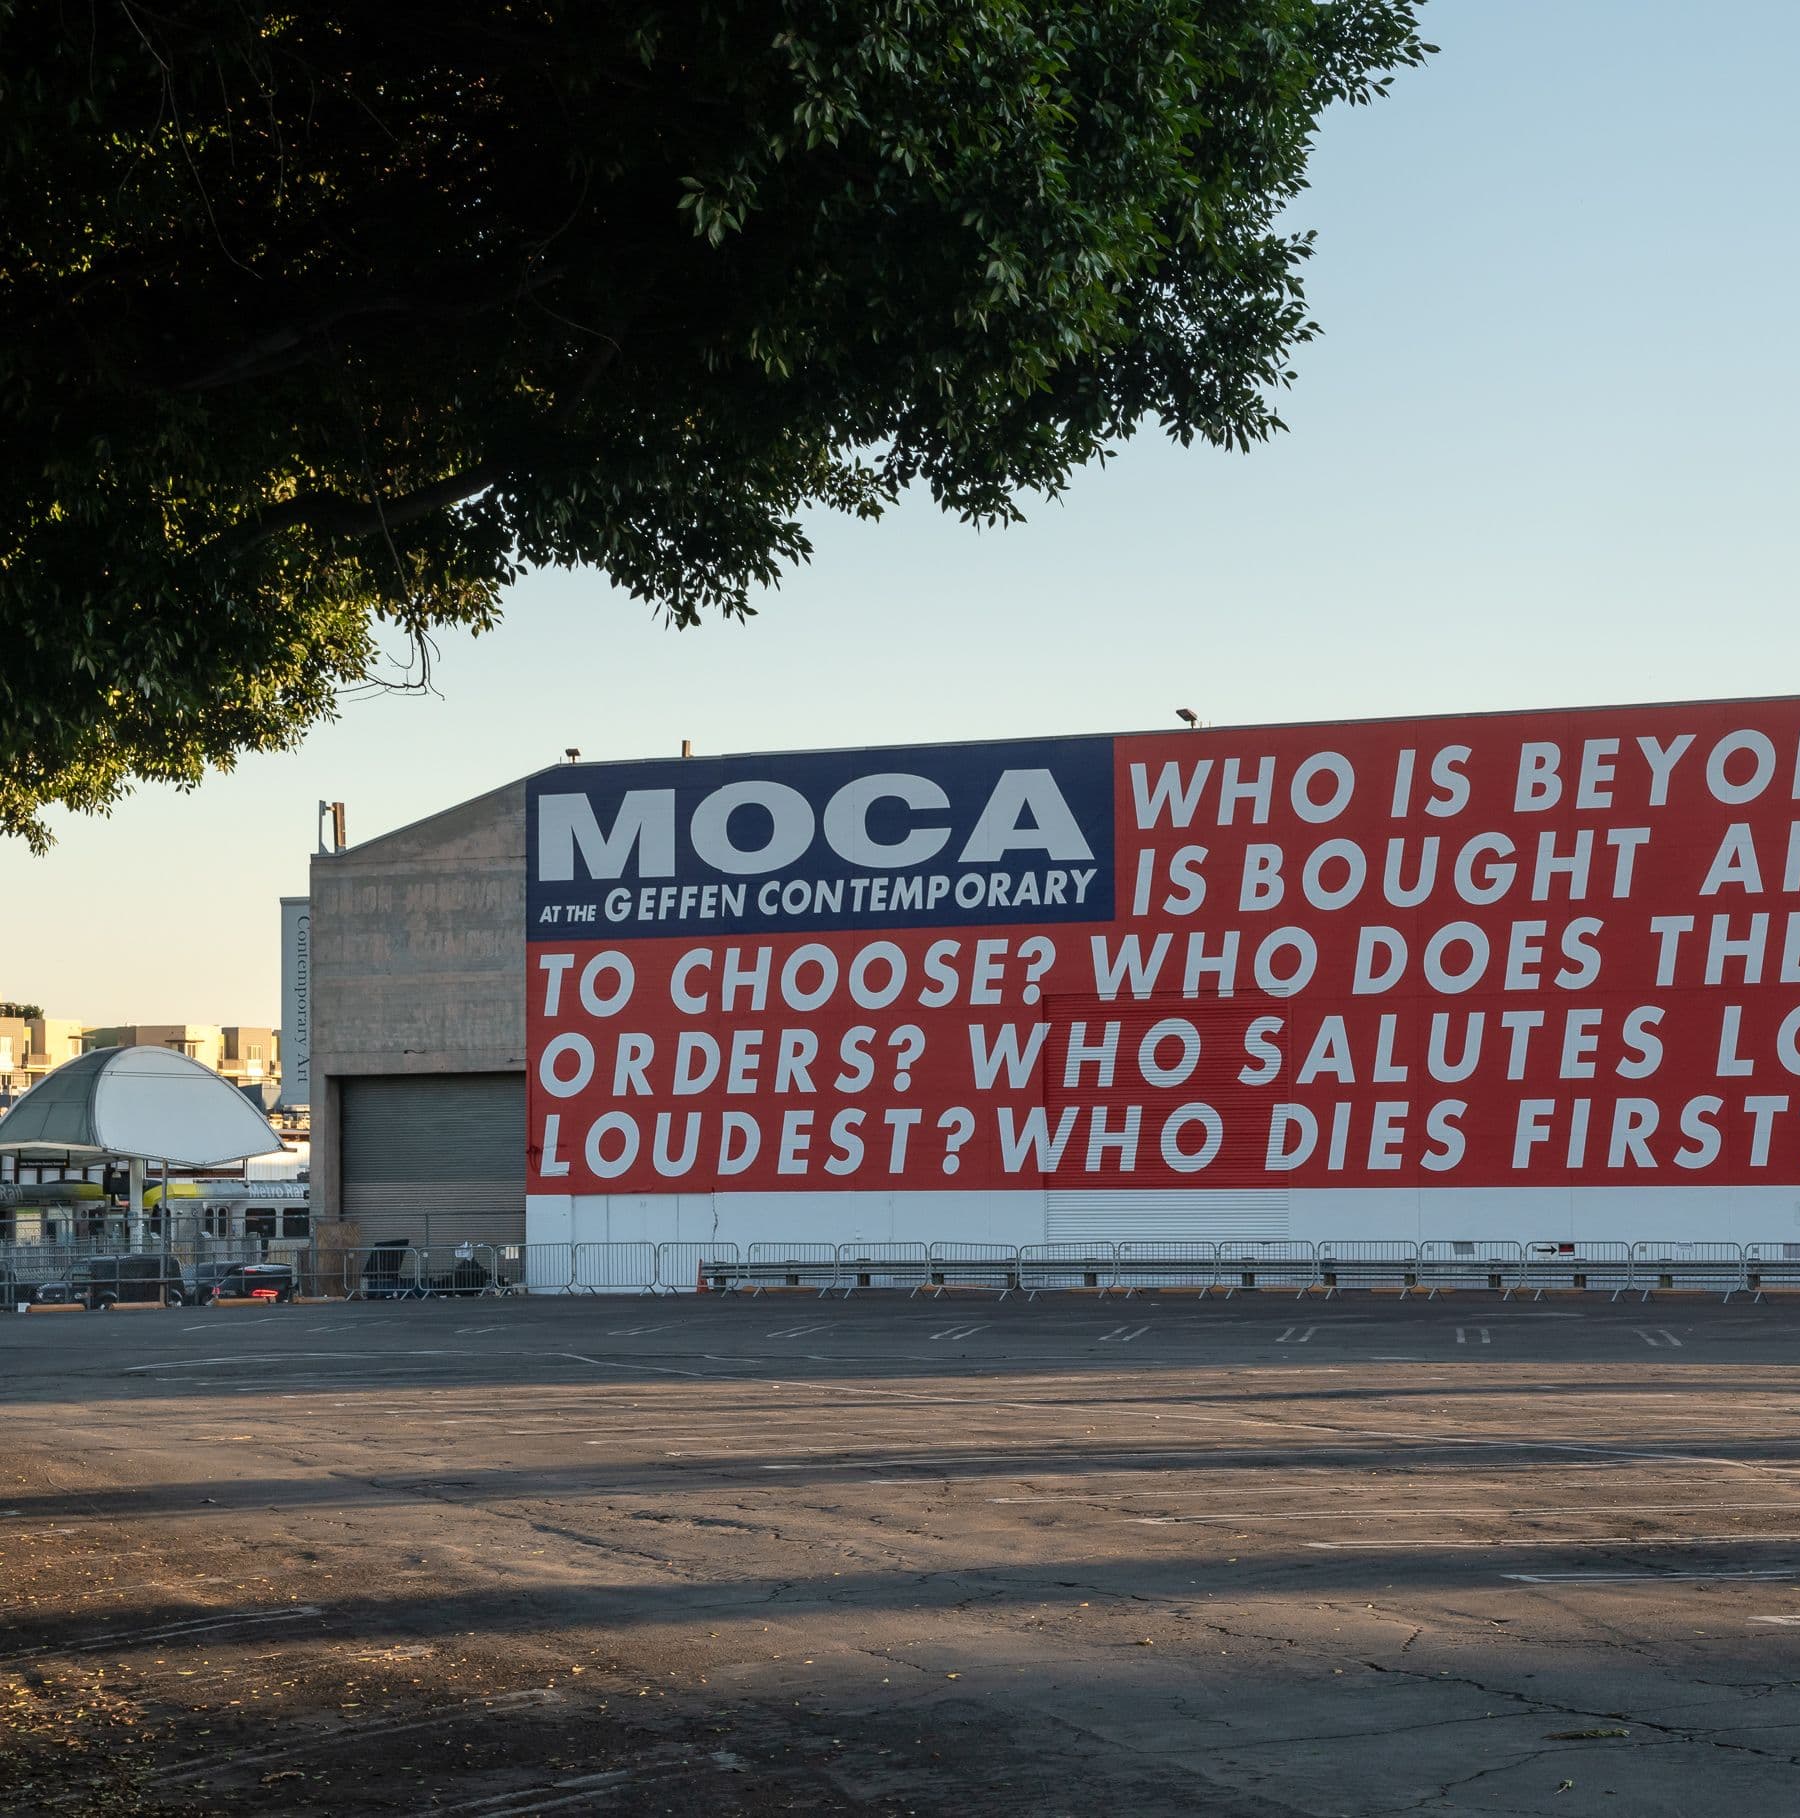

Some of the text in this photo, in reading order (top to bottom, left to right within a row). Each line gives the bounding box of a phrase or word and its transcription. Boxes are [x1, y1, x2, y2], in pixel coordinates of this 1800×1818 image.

[539, 769, 1094, 881] MOCA
[1130, 752, 1354, 829] WHO
[1391, 745, 1472, 817] IS
[540, 869, 1097, 923] AT THE GEFFEN CONTEMPORARY
[1133, 845, 1208, 915] IS
[1239, 828, 1650, 911] BOUGHT
[295, 915, 310, 1082] Contemporary Art
[540, 951, 634, 1017] TO
[671, 936, 1056, 1014] CHOOSE?
[1091, 927, 1317, 997] WHO
[1352, 917, 1603, 994] DOES
[540, 1025, 925, 1097] ORDERS?
[969, 1016, 1201, 1089] WHO
[1237, 1006, 1665, 1085] SALUTES
[540, 1107, 975, 1178] LOUDEST?
[997, 1103, 1223, 1172] WHO
[1265, 1099, 1467, 1171] DIES
[249, 1183, 284, 1198] Metro
